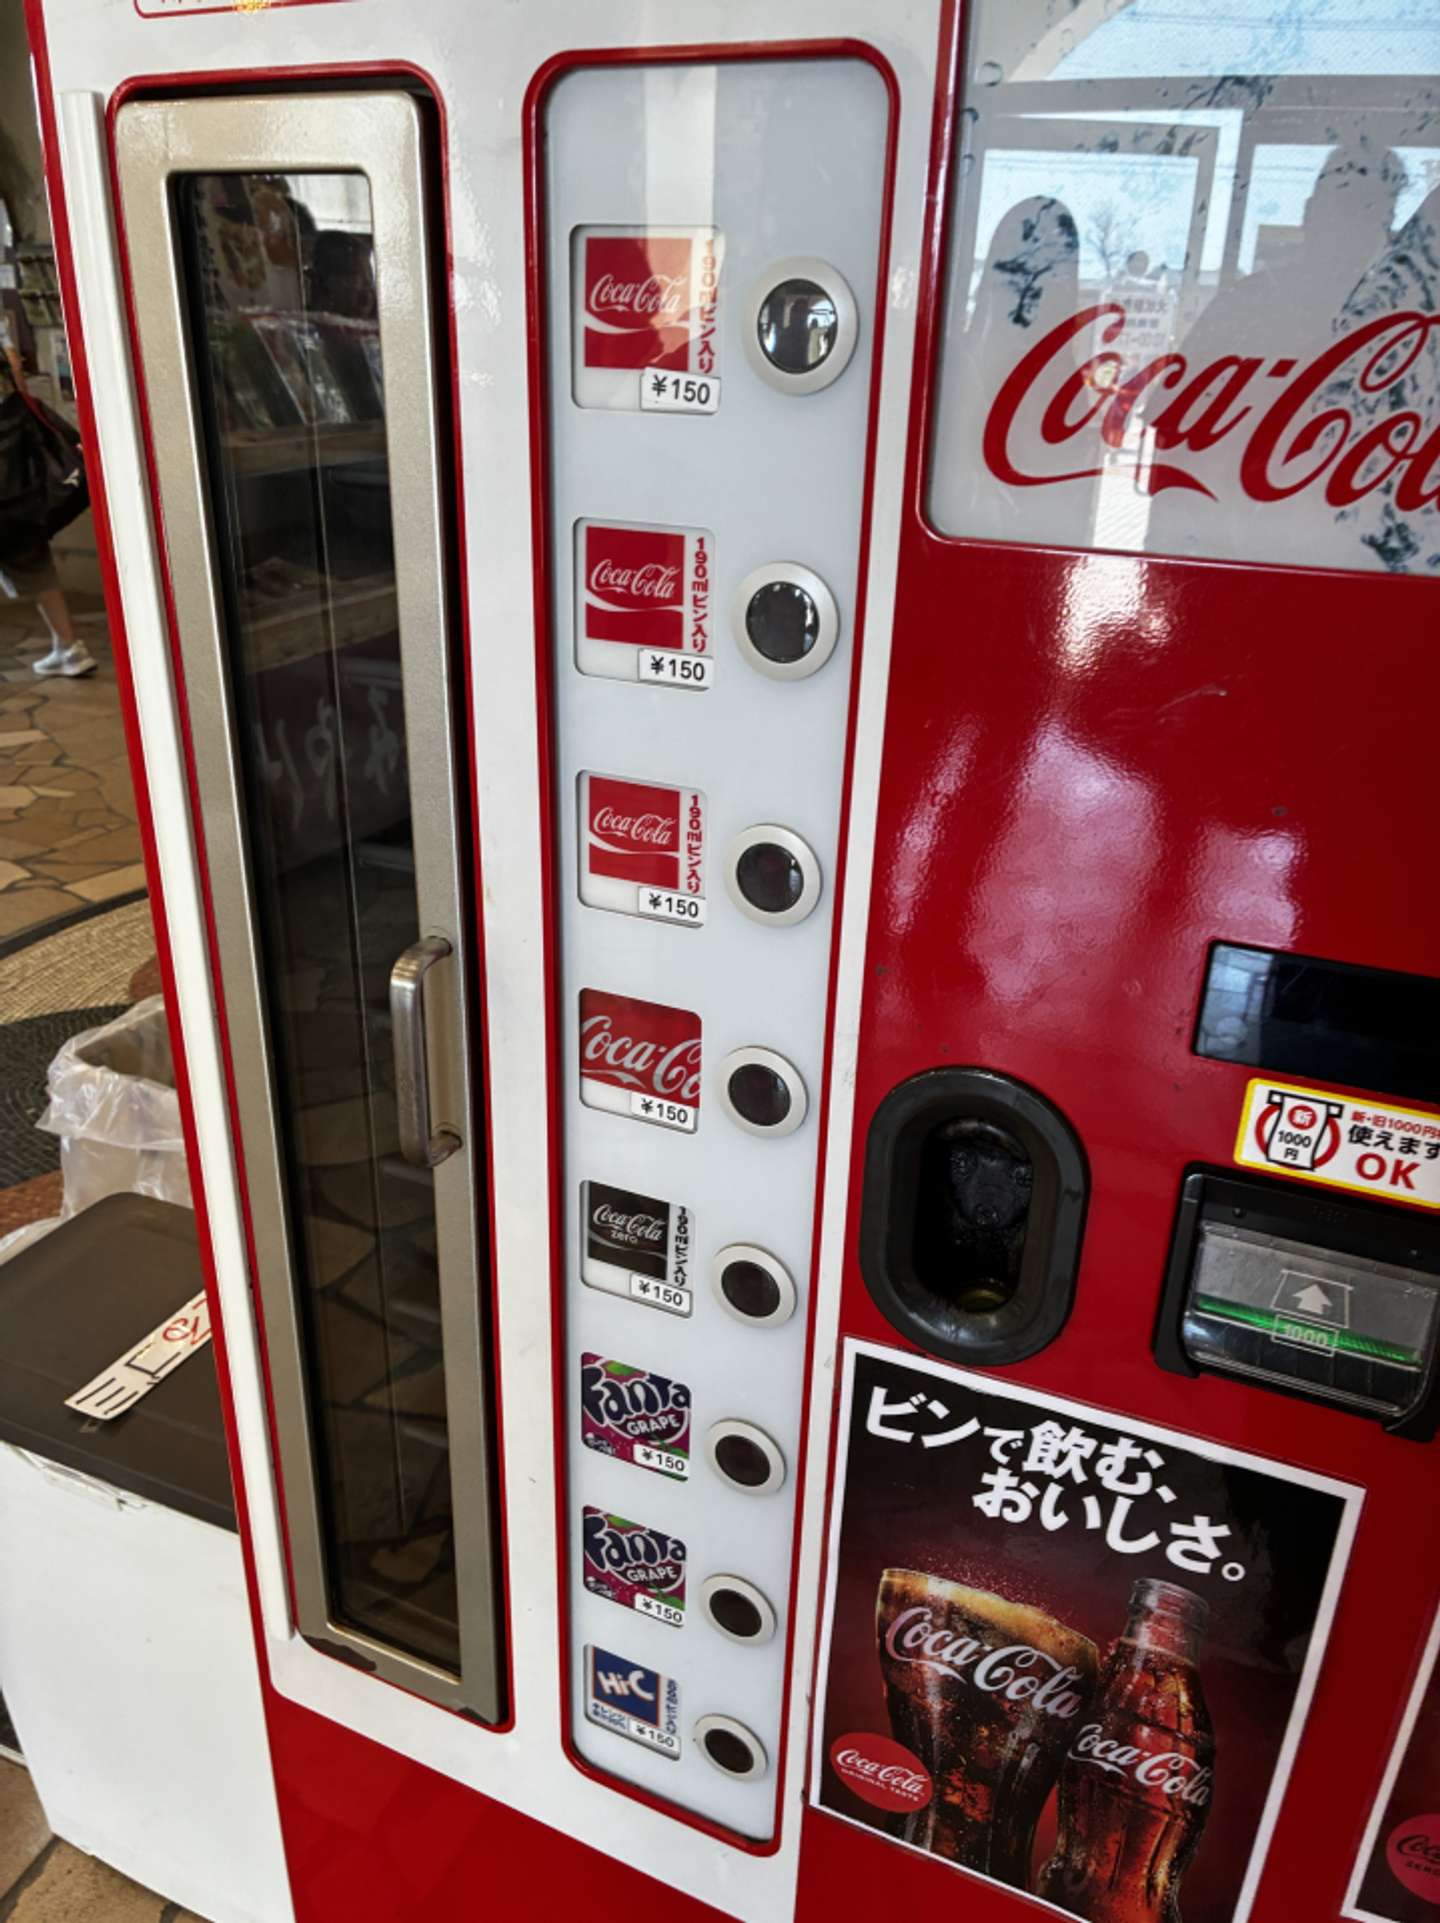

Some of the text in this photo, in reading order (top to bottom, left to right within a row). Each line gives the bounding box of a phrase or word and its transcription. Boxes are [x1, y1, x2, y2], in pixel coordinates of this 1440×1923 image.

[590, 273, 688, 315] Coca-Cola
[651, 374, 711, 405] ¥150
[590, 559, 681, 599] Coca-Cola
[650, 654, 705, 682] ¥150
[593, 806, 677, 845] Coca-Cola
[648, 892, 700, 918] ¥150
[641, 1097, 688, 1124] ¥150
[1277, 1130, 1312, 1148] 1000
[1283, 1147, 1299, 1160] 円
[1355, 1152, 1421, 1190] OK
[593, 1203, 666, 1241] Coca-Cola
[638, 1279, 684, 1307] ¥150
[581, 1365, 691, 1425] Fanta
[626, 1414, 680, 1436] GRAPE
[641, 1447, 686, 1472] ¥150
[865, 1386, 1178, 1504] ビンで飲む、
[583, 1515, 686, 1570] Fanta
[971, 1466, 1246, 1582] おいしさ。
[626, 1564, 678, 1583] GRAPE
[641, 1596, 684, 1624] ¥150
[885, 1606, 1085, 1719] Coca-Cola
[836, 1748, 931, 1794] Coca-Cola
[1067, 1723, 1213, 1807] Coca-Cola
